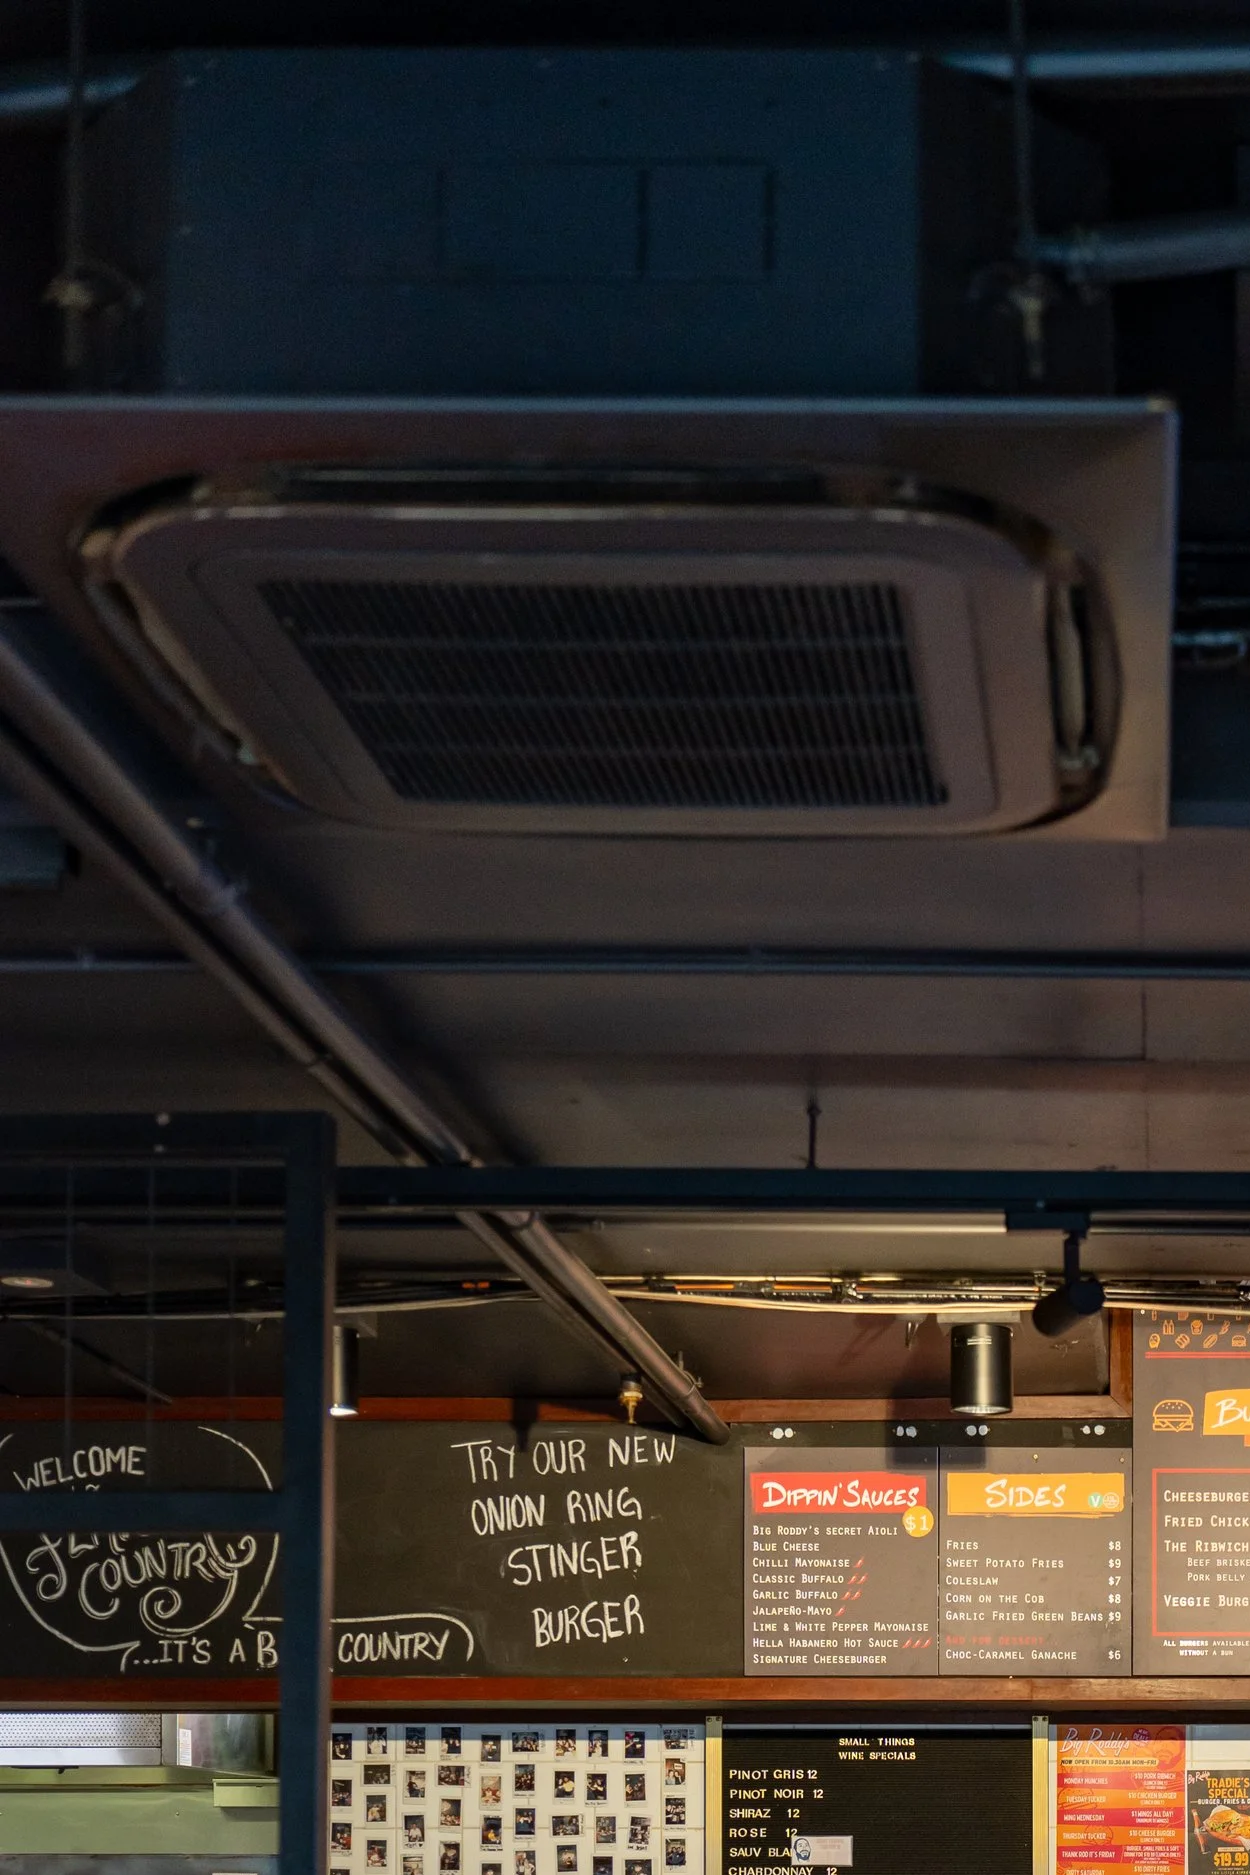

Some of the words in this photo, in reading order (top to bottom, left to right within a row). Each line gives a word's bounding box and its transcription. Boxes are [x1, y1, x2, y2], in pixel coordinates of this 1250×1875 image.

[450, 1439, 516, 1484] TRY
[532, 1439, 587, 1476] OUR
[608, 1434, 676, 1468] NEW
[14, 1446, 147, 1490] WELCOME
[843, 1480, 920, 1509] SAUCES
[984, 1478, 1068, 1508] SIDES
[470, 1494, 546, 1536] ONION
[566, 1486, 643, 1524] RING
[905, 1515, 929, 1533] $1
[1164, 1514, 1203, 1527] FRIED
[753, 1541, 777, 1552] BLUE
[782, 1541, 820, 1552] CHEESE
[946, 1539, 979, 1551] FRIES
[1108, 1540, 1122, 1551] $8
[1164, 1539, 1187, 1552] THE
[1195, 1539, 1249, 1553] RIBWICH
[507, 1530, 642, 1586] STINGER
[752, 1557, 789, 1568] CHILLI
[794, 1557, 850, 1568] MAYONAISE
[946, 1557, 979, 1568] SWEET
[985, 1557, 1025, 1568] POTATO
[1032, 1557, 1064, 1569] FRIES
[1108, 1558, 1122, 1569] $9
[752, 1573, 796, 1584] CLASSIC
[801, 1573, 844, 1584] BUFFALO
[945, 1575, 999, 1586] COLESLAW
[1108, 1575, 1122, 1586] $7
[1163, 1594, 1210, 1607] VEGGIE
[532, 1594, 644, 1648] BURGER
[229, 1638, 246, 1662] A
[338, 1628, 450, 1663] COUNTRY
[838, 1737, 870, 1746] SMALL
[877, 1737, 915, 1746] THINGS
[838, 1751, 864, 1761] WINE
[869, 1751, 916, 1761] SPECIALS
[729, 1769, 769, 1780] PINOT
[773, 1769, 804, 1780] GRIS
[806, 1769, 818, 1780] 12
[729, 1788, 767, 1800] PINOT
[773, 1788, 804, 1799] NOIR
[812, 1788, 824, 1799] 12
[1208, 1788, 1249, 1799] SPECIAL
[729, 1808, 771, 1819] SHIRAZ
[787, 1808, 800, 1818] 12
[729, 1827, 767, 1838] ROSE
[1213, 1852, 1249, 1867] $19.99
